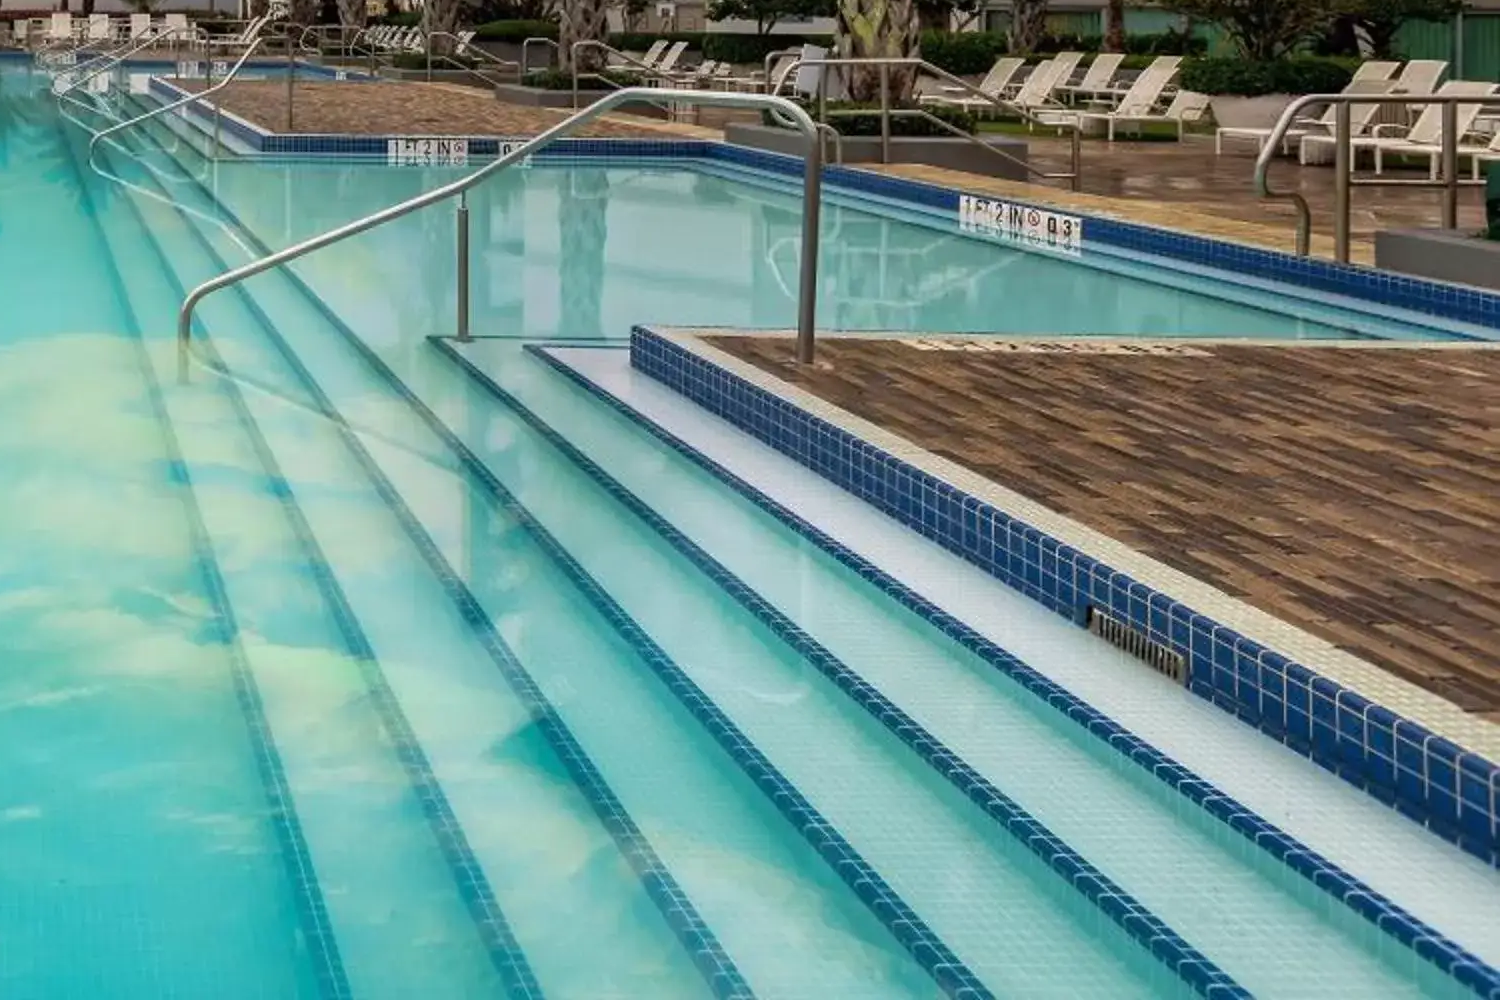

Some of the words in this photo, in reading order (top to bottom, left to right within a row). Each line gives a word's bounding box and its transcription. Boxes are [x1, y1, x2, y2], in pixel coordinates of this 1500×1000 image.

[437, 140, 450, 154] IN
[996, 203, 1003, 222] 2
[1010, 206, 1024, 226] IN
